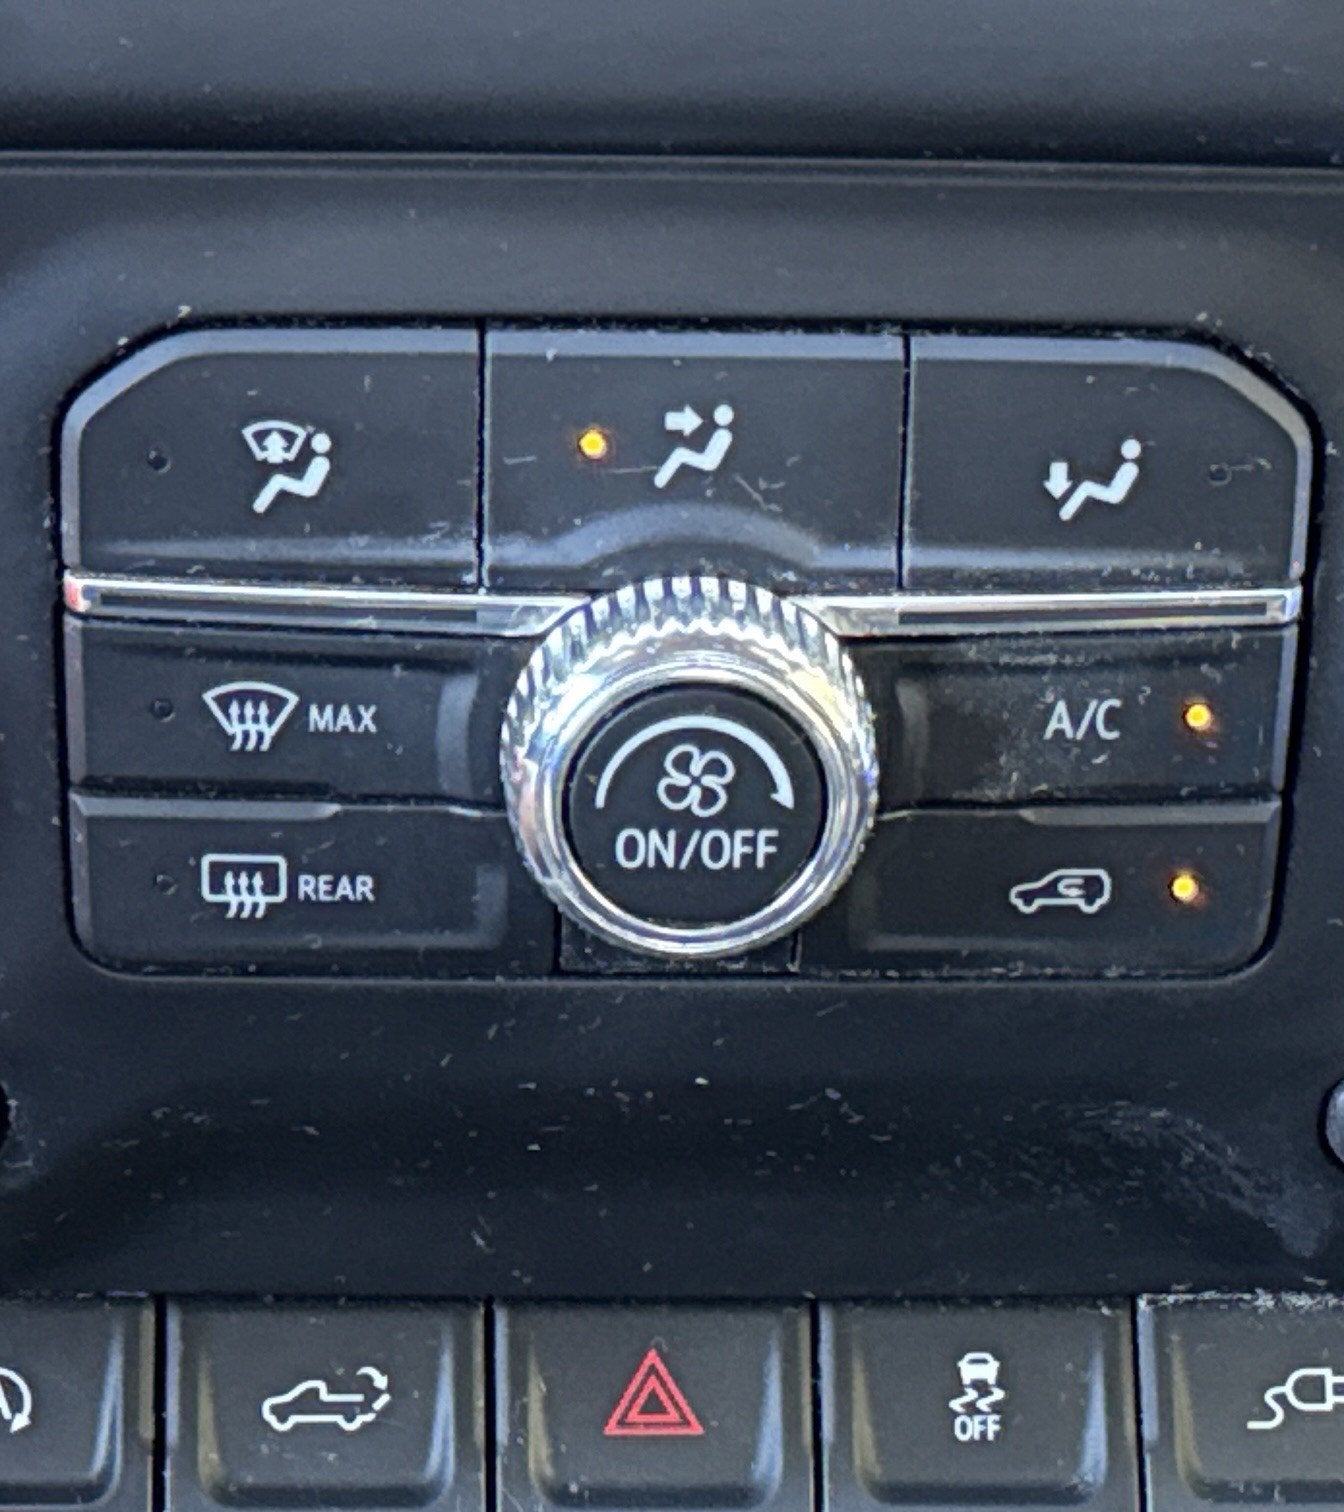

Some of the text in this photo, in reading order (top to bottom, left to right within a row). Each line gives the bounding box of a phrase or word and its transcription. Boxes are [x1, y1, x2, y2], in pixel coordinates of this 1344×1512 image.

[308, 703, 378, 734] MAX
[1043, 697, 1122, 741] A/C
[614, 827, 779, 871] ON/OFF
[297, 873, 376, 902] REAR
[953, 1414, 1001, 1442] OFF
